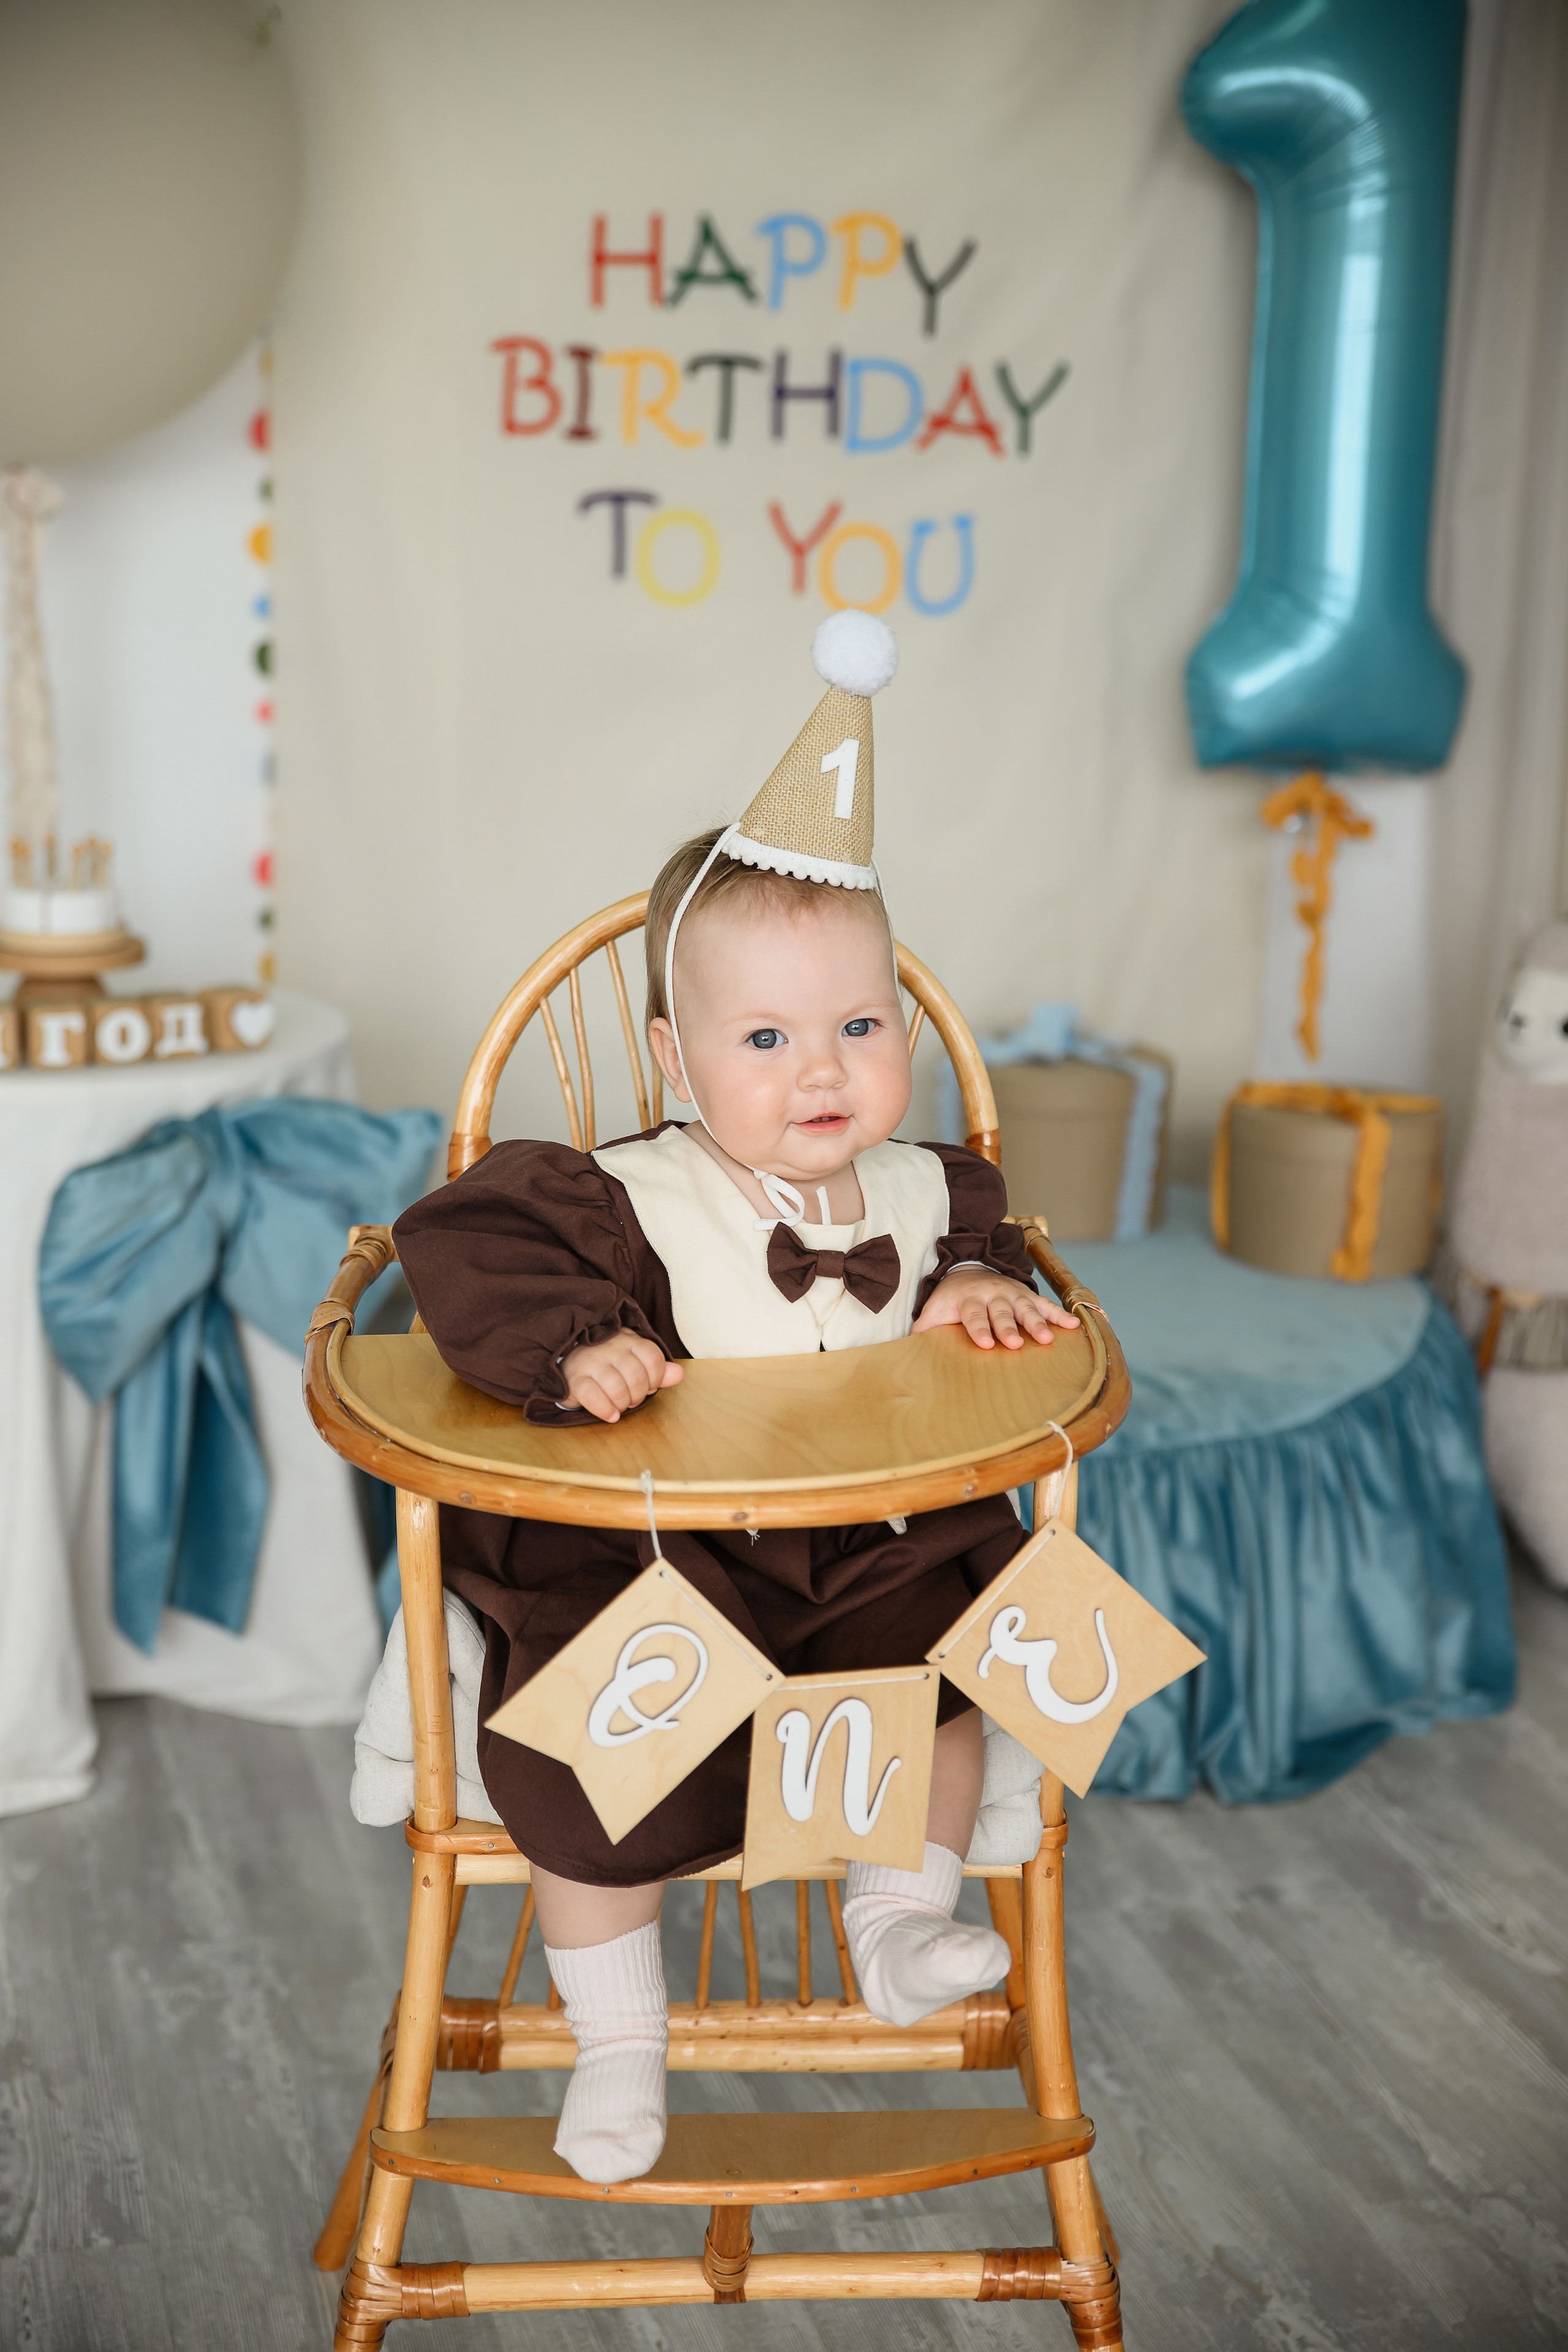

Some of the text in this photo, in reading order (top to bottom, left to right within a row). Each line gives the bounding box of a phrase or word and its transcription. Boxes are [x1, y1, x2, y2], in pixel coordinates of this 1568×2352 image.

[589, 211, 979, 338] HAPPY
[489, 336, 1071, 459] BIRTHDAY
[1180, 0, 1470, 774] 1
[576, 488, 976, 618] TO YOU
[820, 737, 860, 820] 1
